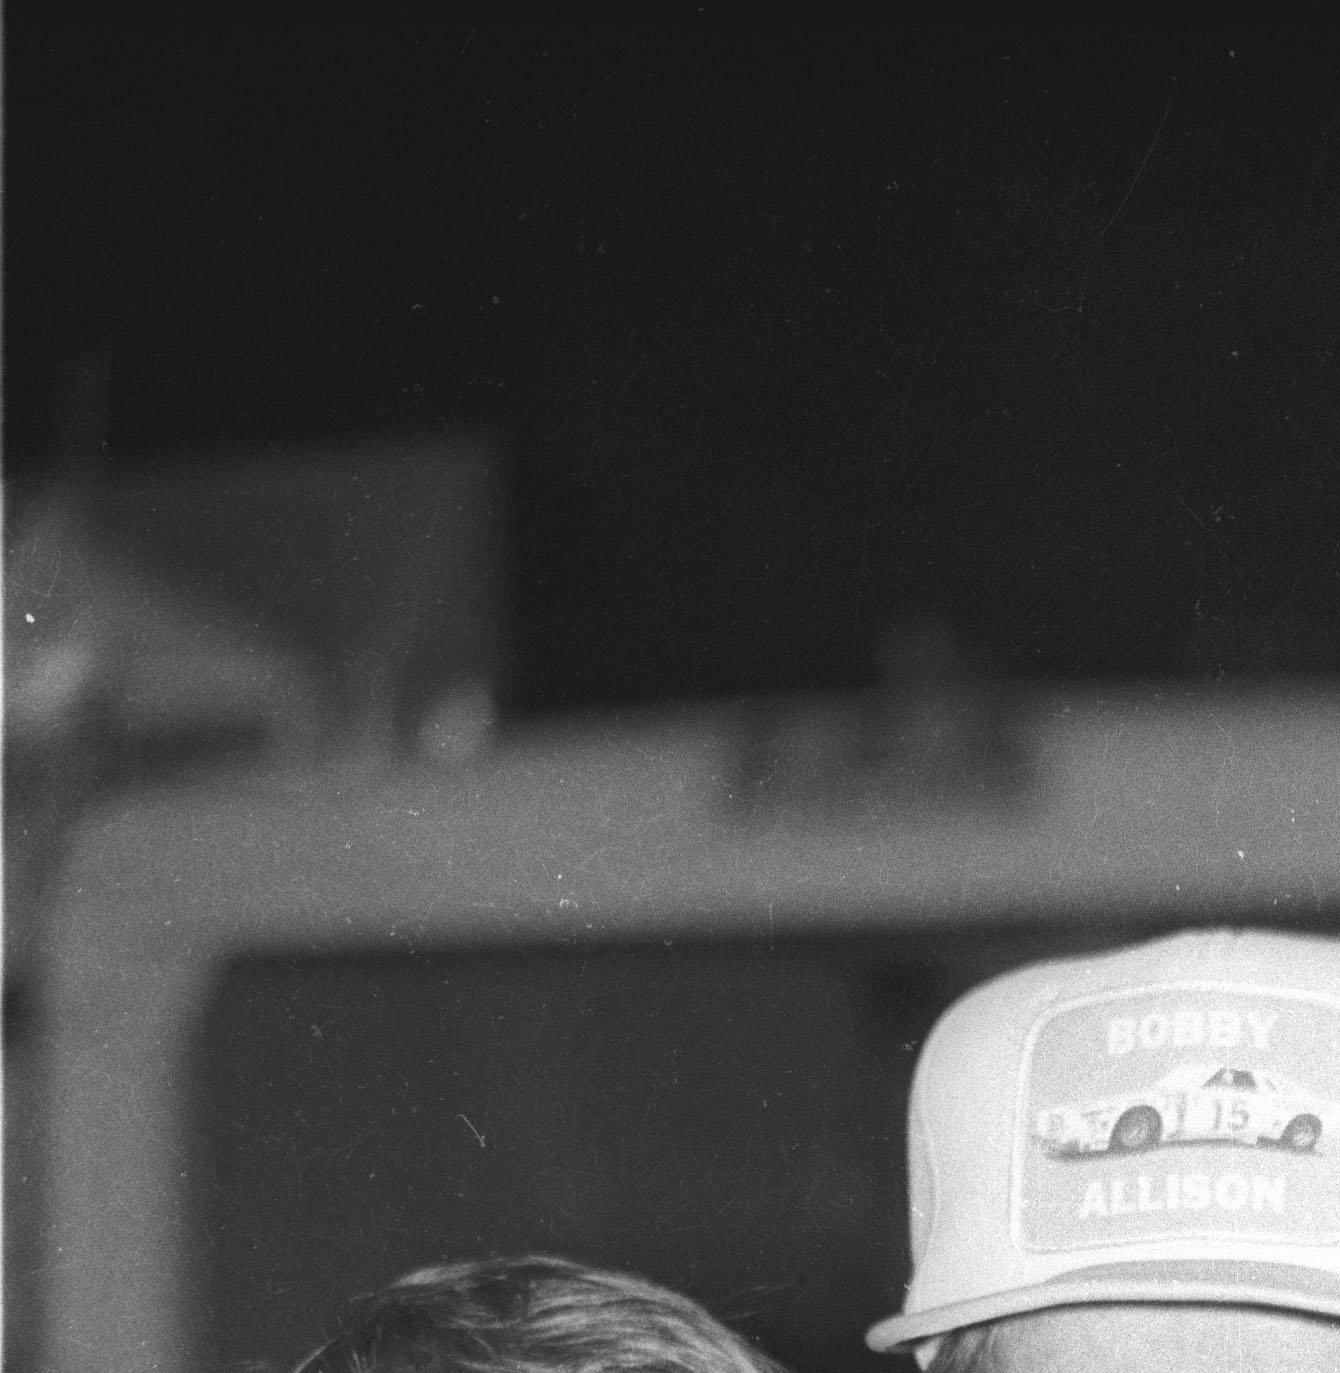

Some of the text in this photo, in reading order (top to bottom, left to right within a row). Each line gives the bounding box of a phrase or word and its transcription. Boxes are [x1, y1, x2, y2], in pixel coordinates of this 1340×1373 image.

[1107, 1012, 1278, 1056] BOBBY
[1212, 1099, 1251, 1132] 15
[1079, 1172, 1287, 1219] ALLISON
